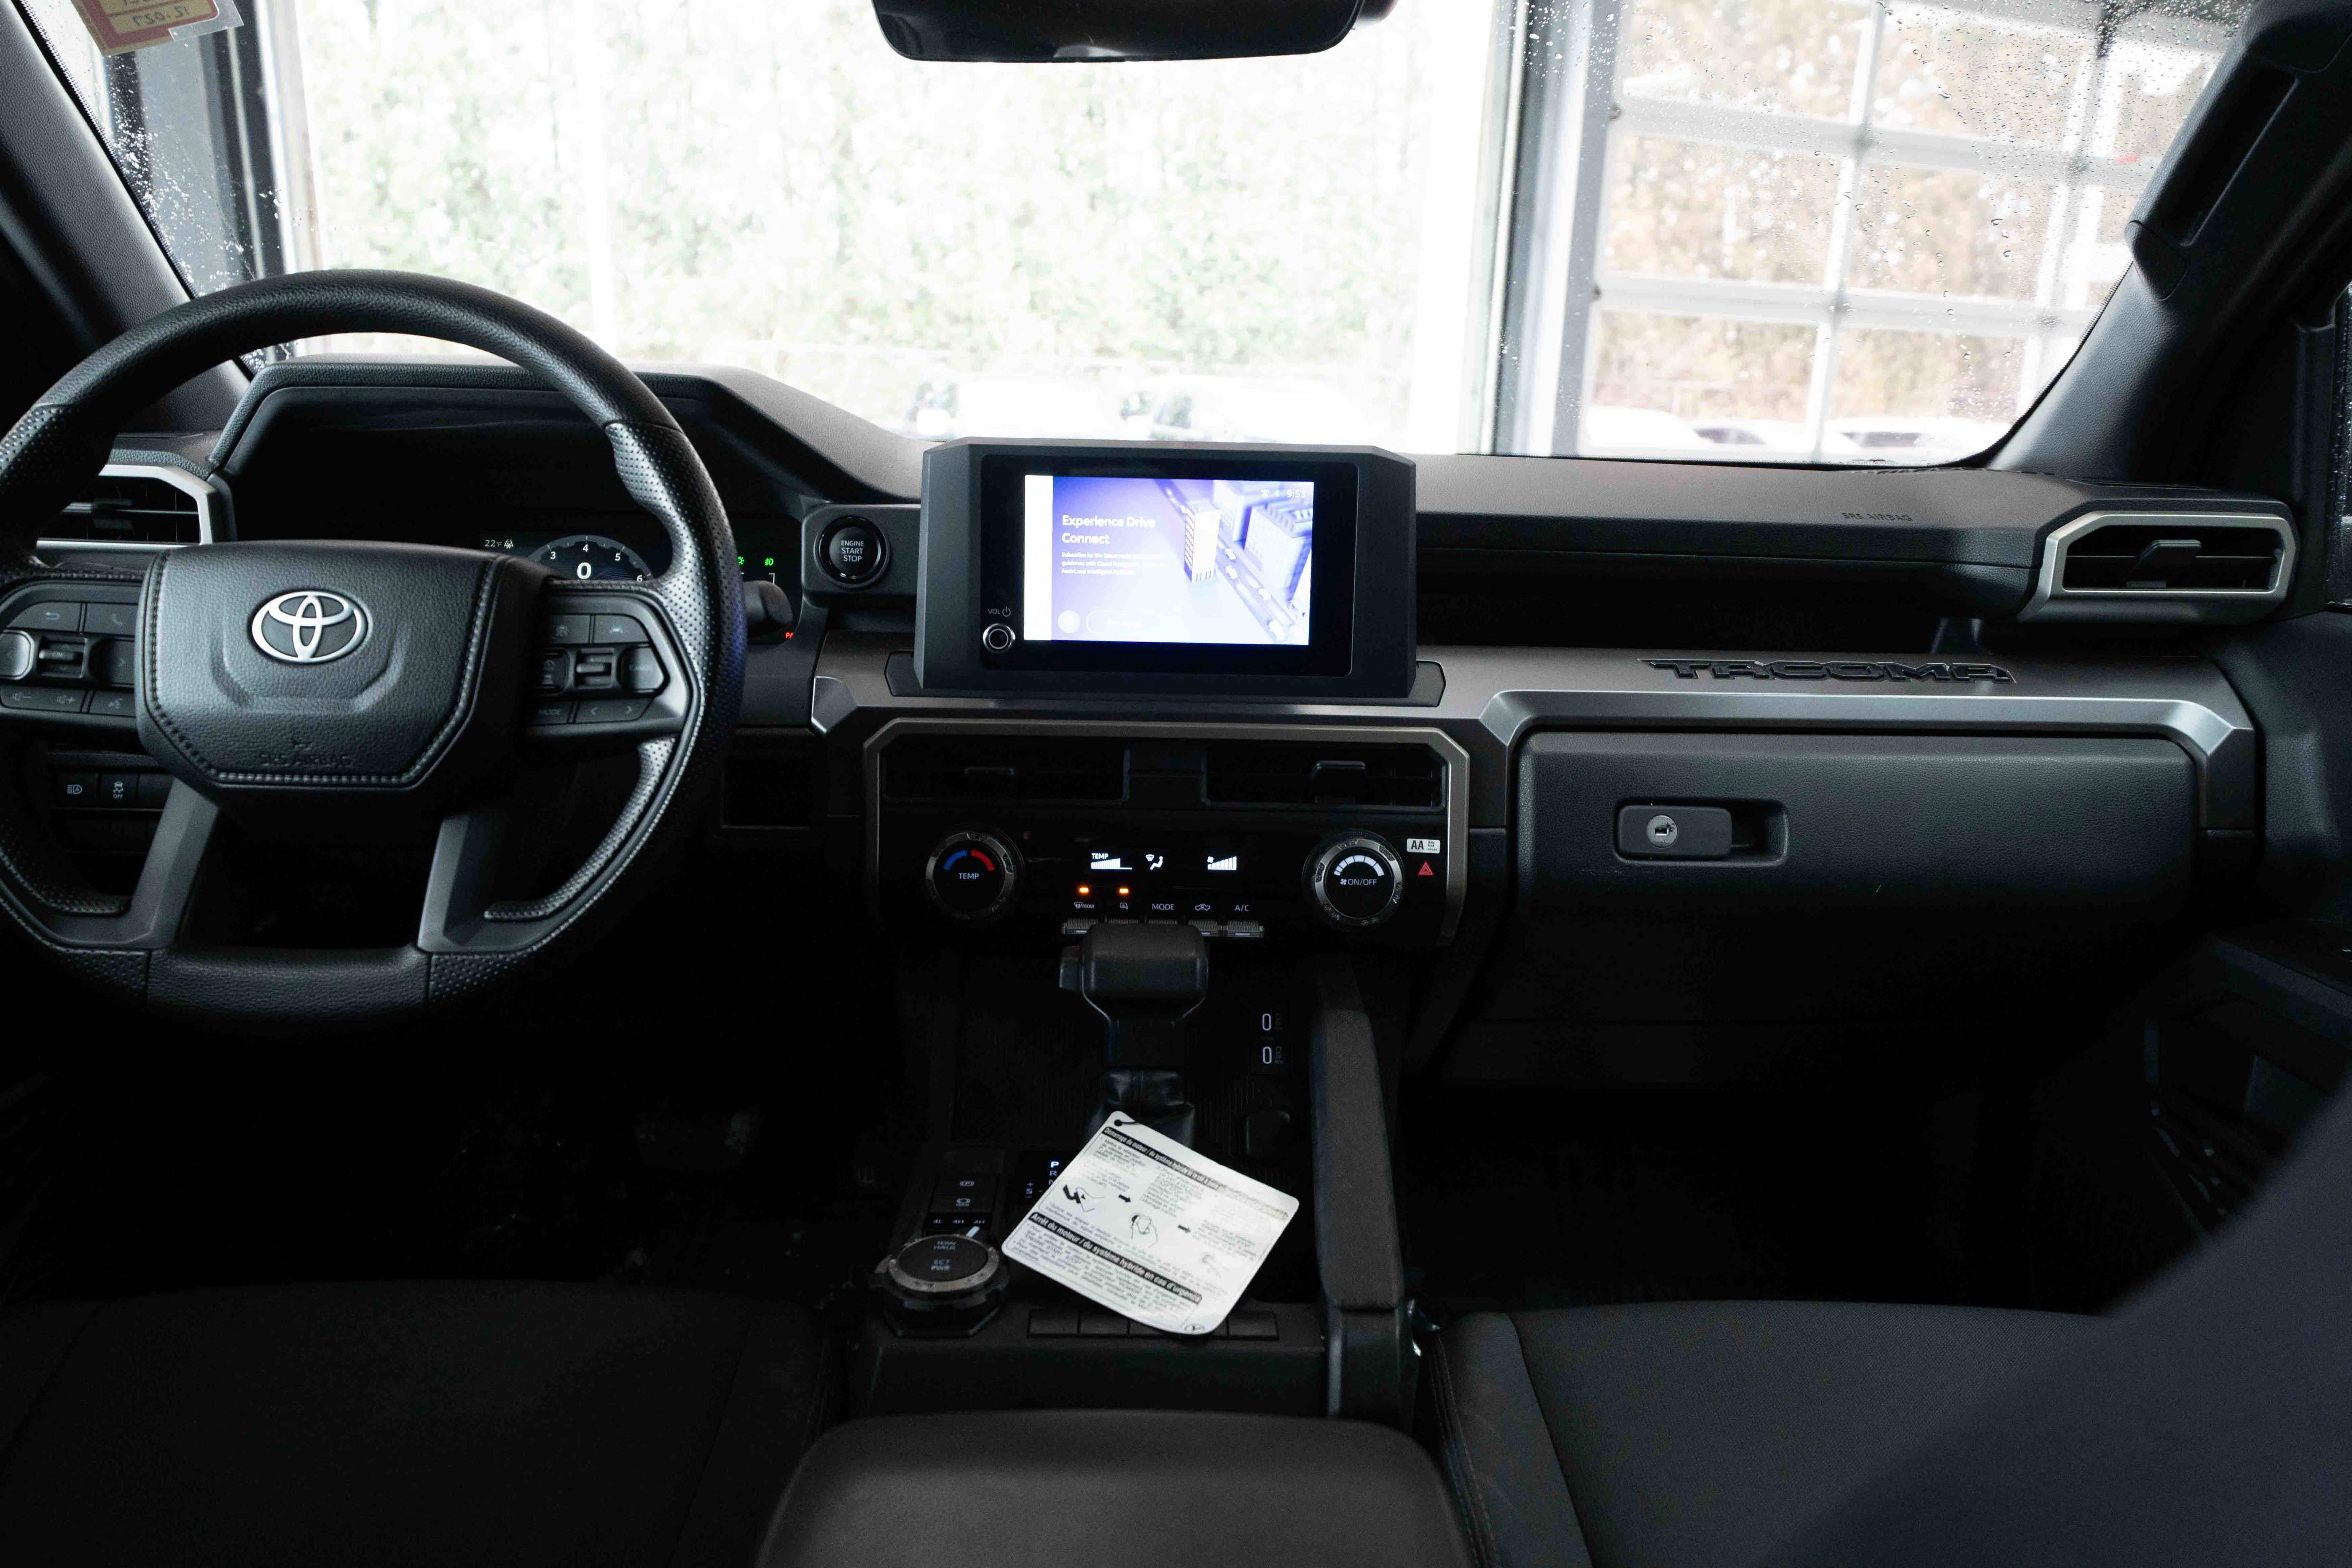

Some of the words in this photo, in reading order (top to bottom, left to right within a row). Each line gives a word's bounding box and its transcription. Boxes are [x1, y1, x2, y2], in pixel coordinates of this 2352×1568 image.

[1062, 515, 1124, 528] Experience
[1126, 517, 1156, 528] Drive
[1062, 532, 1110, 544] Connect
[582, 544, 588, 552] 4
[550, 551, 556, 559] 3
[615, 553, 621, 561] 5
[577, 562, 592, 579] 0
[1637, 658, 2017, 684] TACOMA
[1411, 840, 1424, 850] AA
[1030, 1212, 1050, 1225] Arrêt
[1055, 1227, 1081, 1243] moteur
